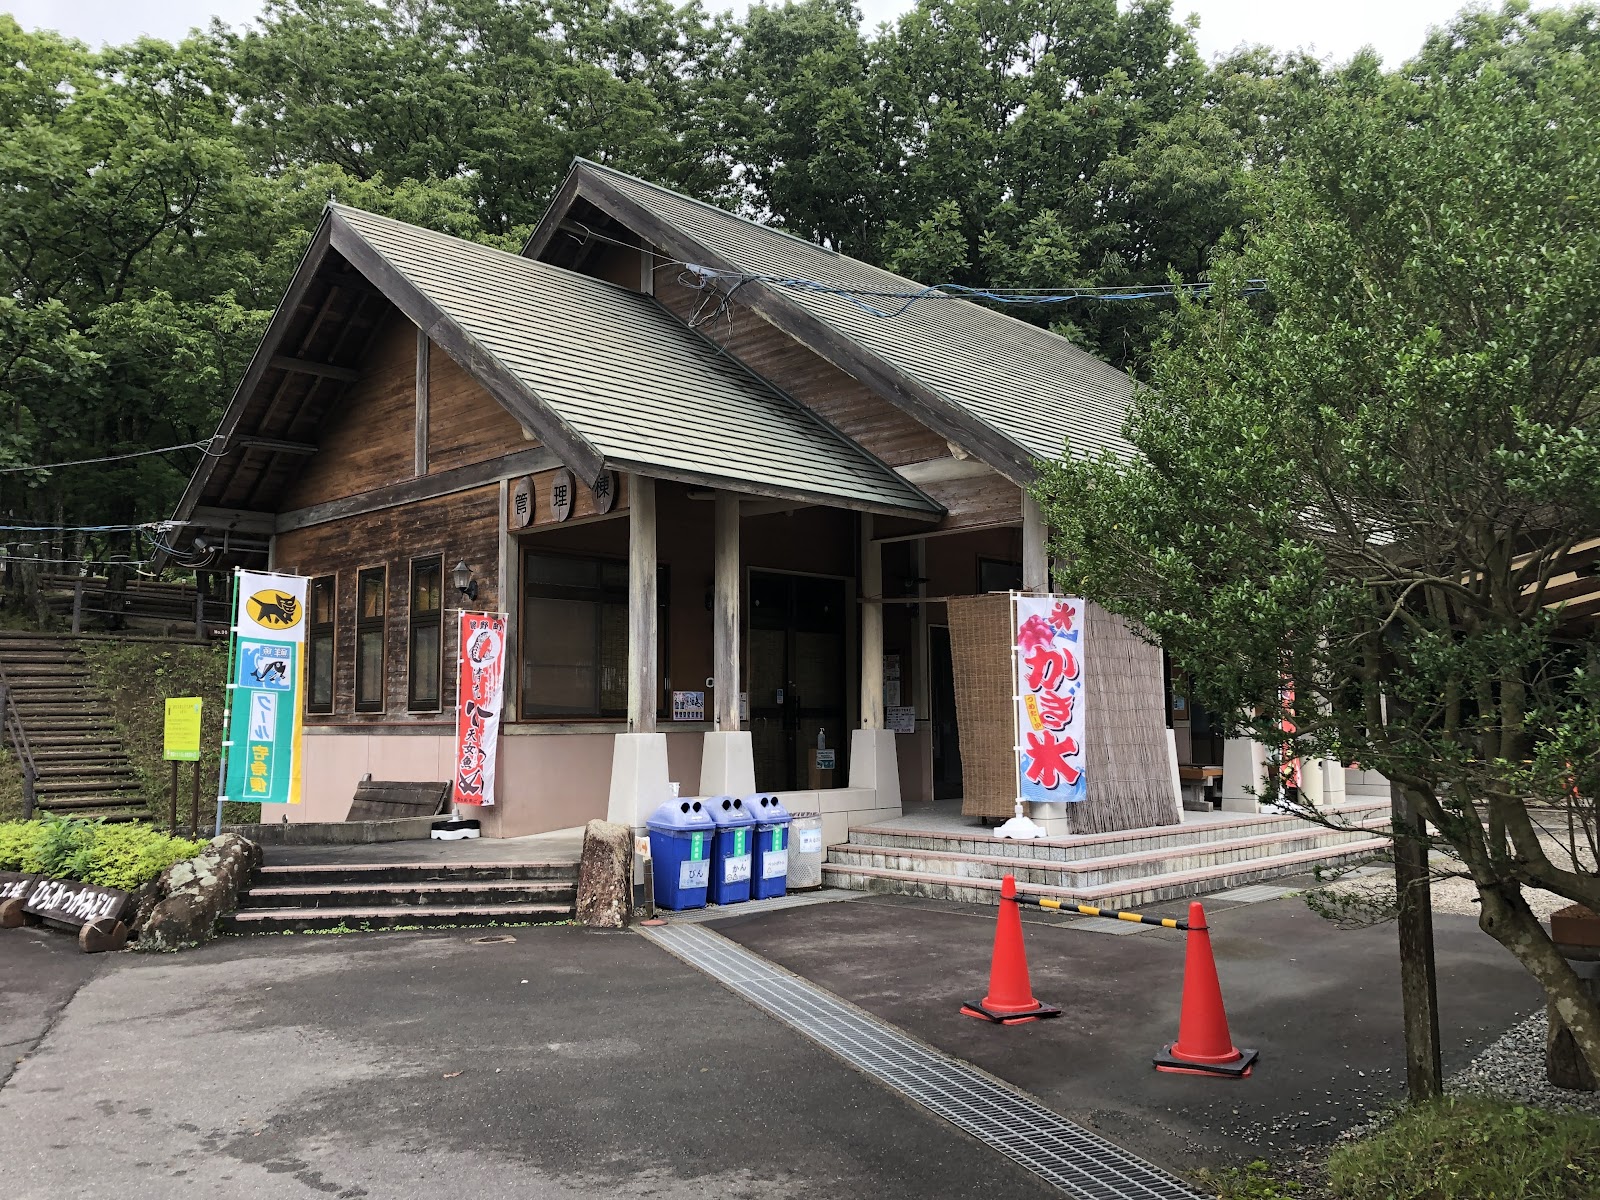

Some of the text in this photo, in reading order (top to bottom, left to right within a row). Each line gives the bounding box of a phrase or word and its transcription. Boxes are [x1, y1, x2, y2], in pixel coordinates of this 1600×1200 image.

[515, 476, 610, 515] 管理棟
[1048, 602, 1076, 631] 氷
[1024, 645, 1080, 790] かき氷
[460, 728, 477, 770] 天女魚
[689, 870, 704, 879] びん
[732, 864, 747, 873] かん
